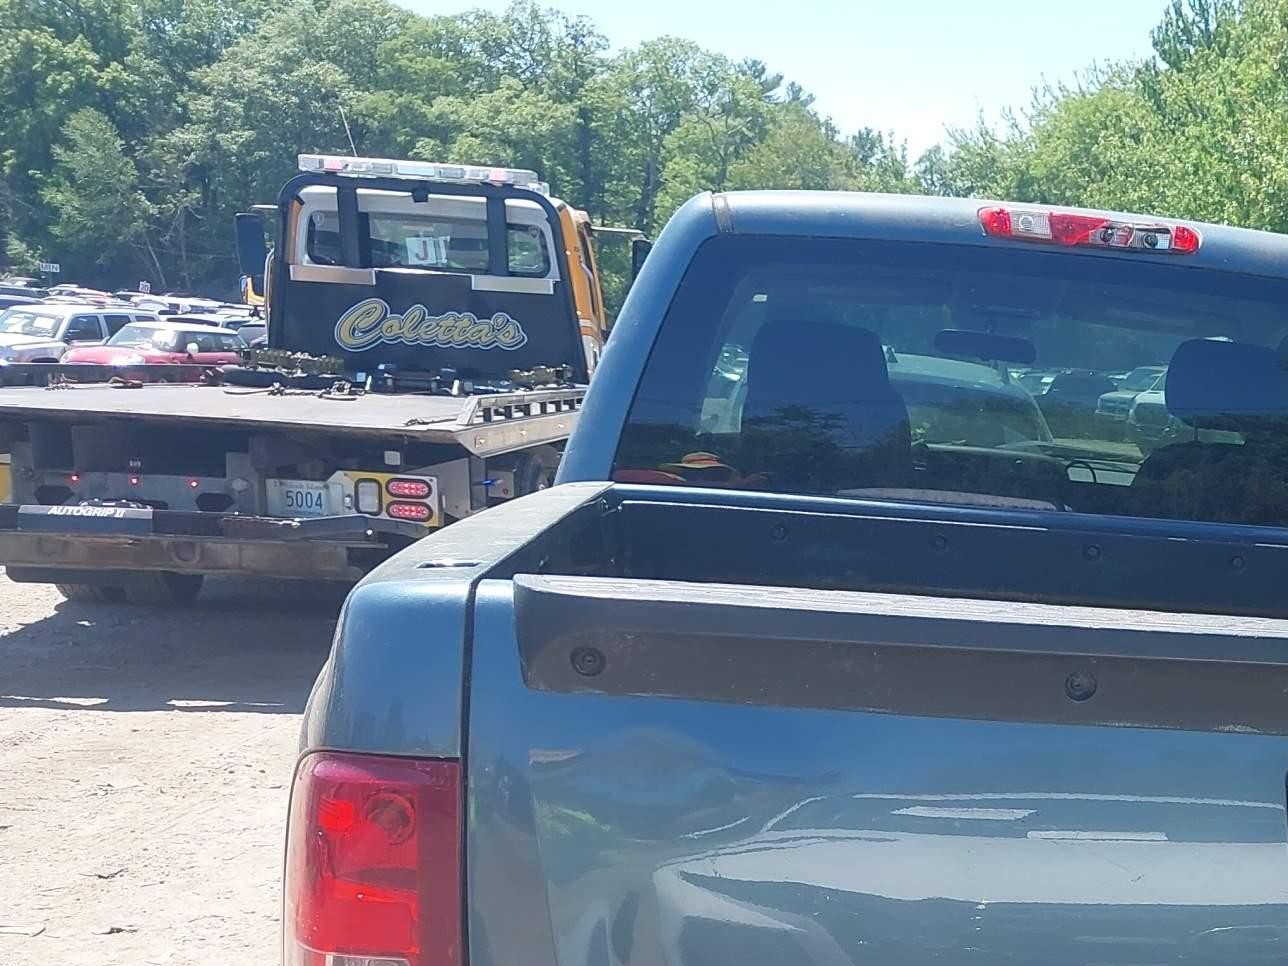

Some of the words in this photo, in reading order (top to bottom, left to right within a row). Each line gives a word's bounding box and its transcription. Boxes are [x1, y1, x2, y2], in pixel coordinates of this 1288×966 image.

[334, 297, 528, 351] Coletta's
[286, 490, 323, 509] 5004
[47, 505, 115, 517] AUTOGRIP
